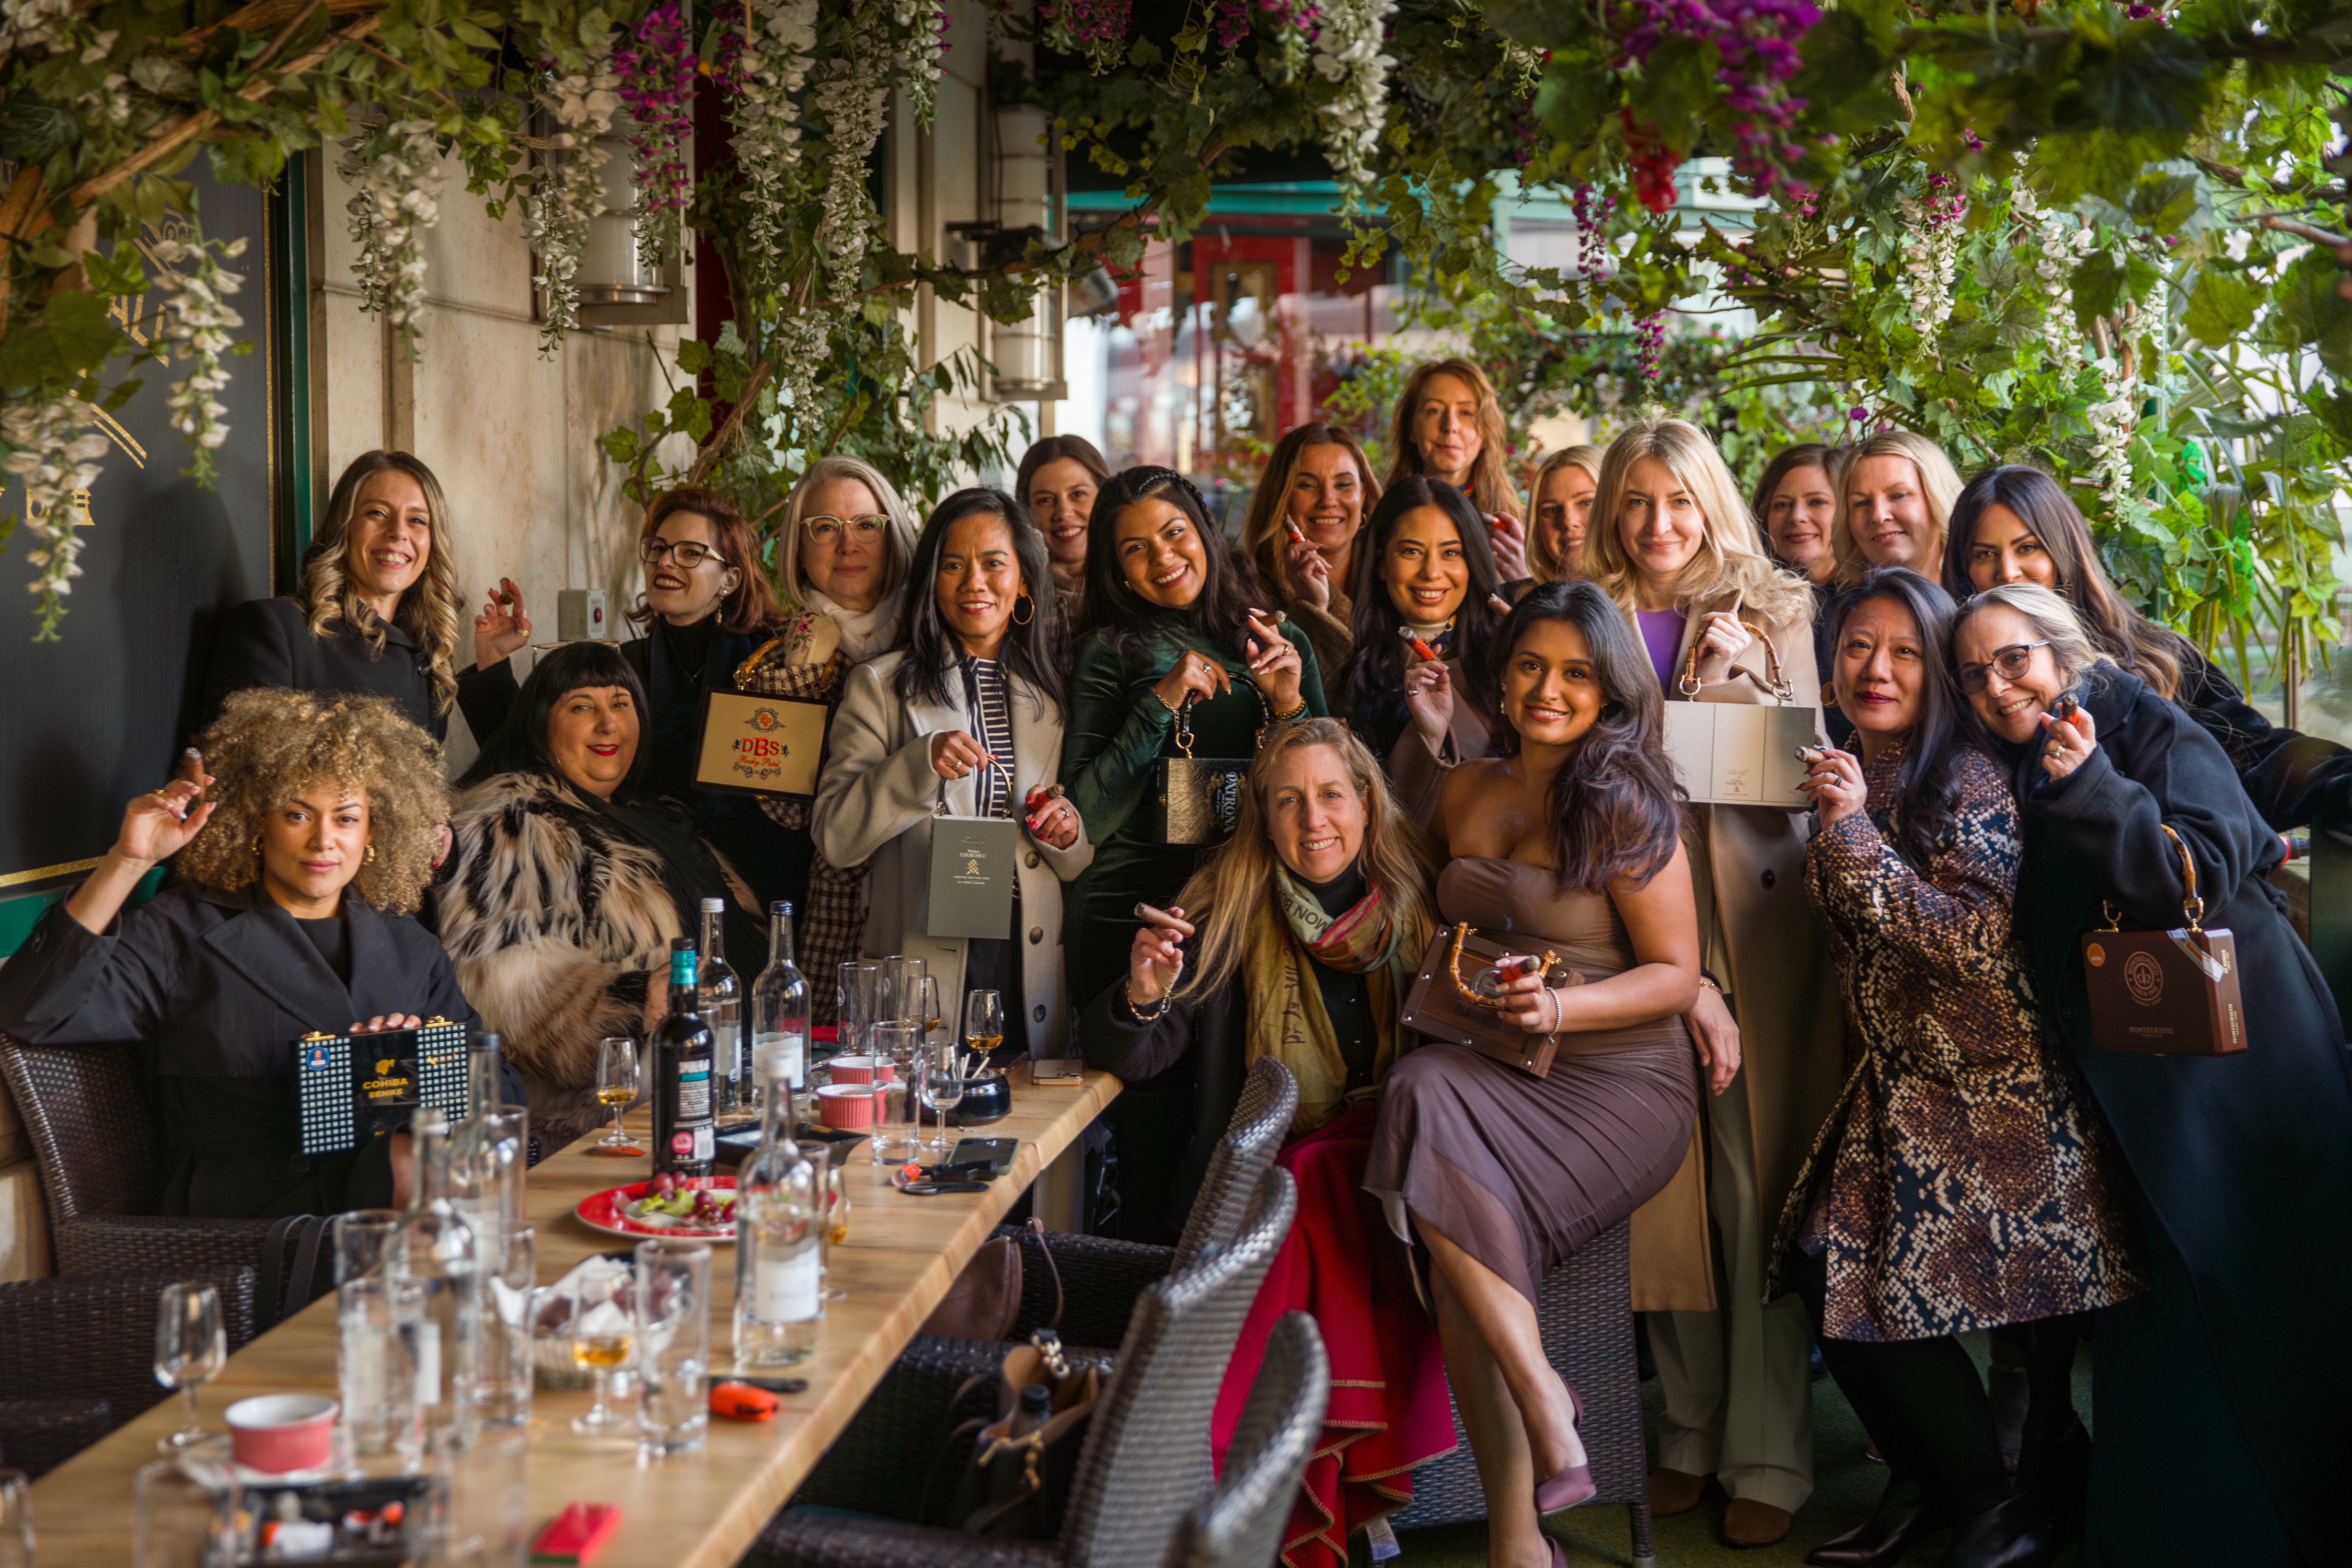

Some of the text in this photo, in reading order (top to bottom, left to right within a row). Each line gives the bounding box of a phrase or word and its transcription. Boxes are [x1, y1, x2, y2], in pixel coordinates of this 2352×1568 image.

[742, 737, 779, 757] DBS
[1224, 771, 1238, 833] PATRONA
[362, 1077, 408, 1090] COHIBA
[368, 1088, 403, 1099] BEHIKE
